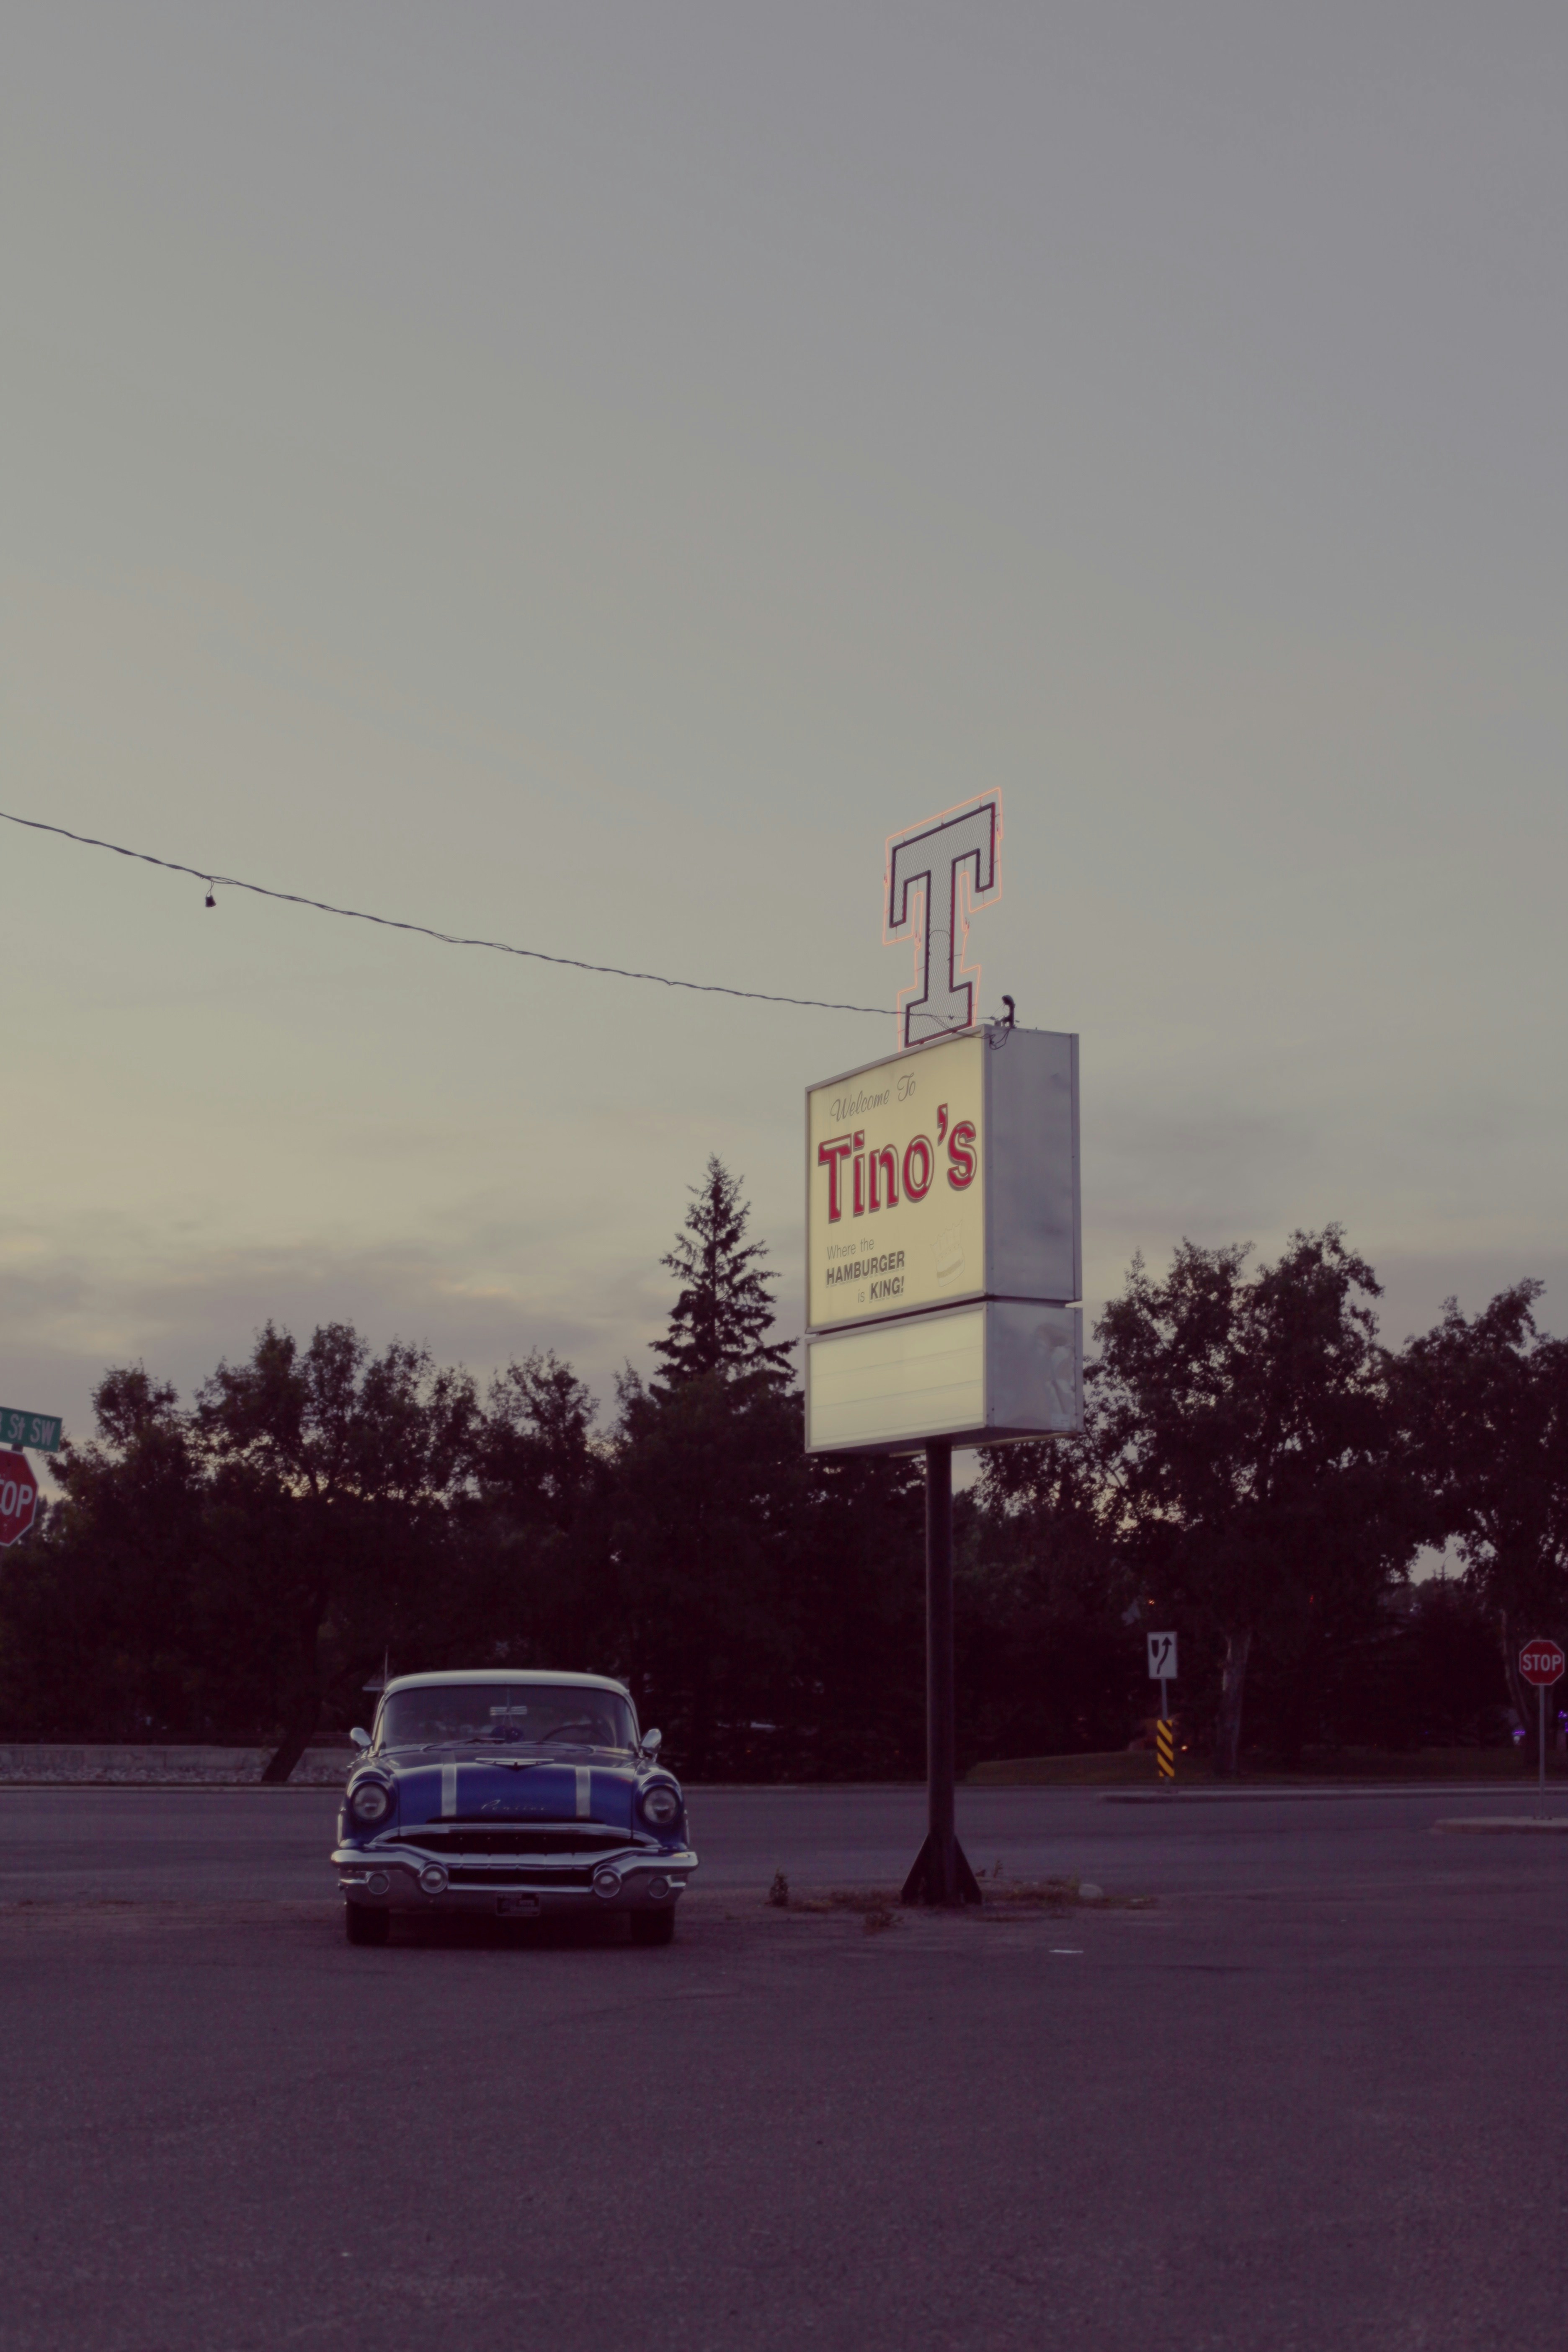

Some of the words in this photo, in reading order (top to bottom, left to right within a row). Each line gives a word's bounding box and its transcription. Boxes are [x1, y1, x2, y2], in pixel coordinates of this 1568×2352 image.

[884, 787, 1002, 1051] T
[830, 1089, 890, 1122] Welcome
[897, 1072, 916, 1102] To
[818, 1102, 977, 1224] Tino's
[827, 1244, 856, 1261] Where
[860, 1237, 874, 1252] the
[826, 1250, 905, 1287] HAMBURGER
[858, 1289, 865, 1303] is
[870, 1275, 905, 1301] KING!
[7, 1413, 25, 1440] St
[29, 1417, 56, 1446] SW
[1522, 1654, 1562, 1671] STOP
